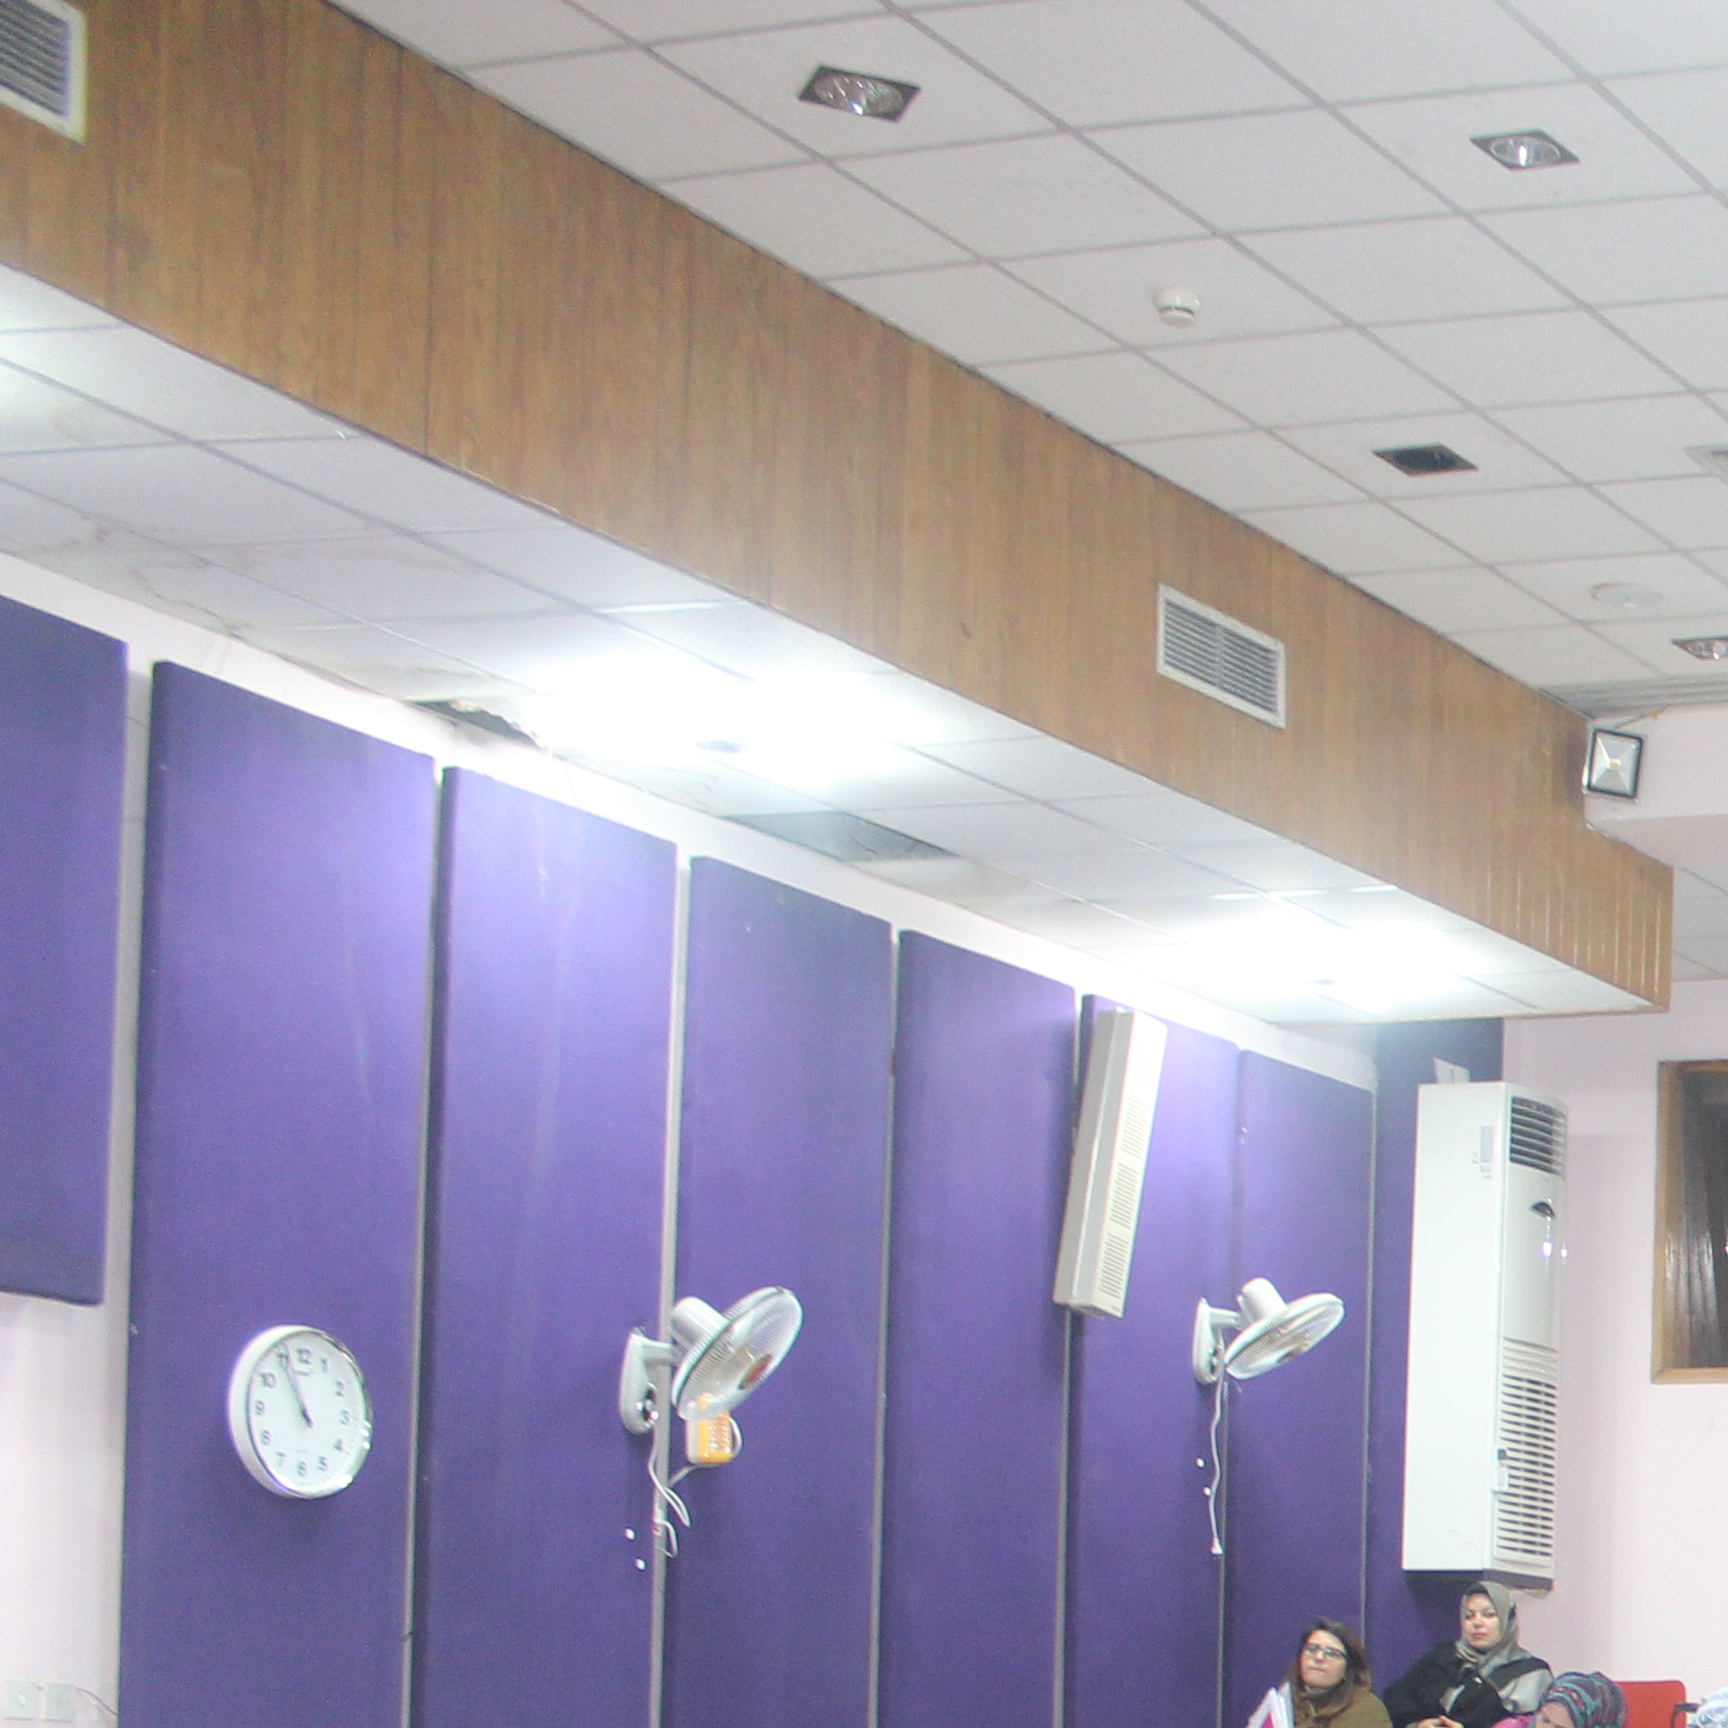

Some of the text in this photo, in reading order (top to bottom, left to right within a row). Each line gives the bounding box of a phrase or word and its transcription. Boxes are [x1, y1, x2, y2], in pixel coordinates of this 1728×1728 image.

[297, 1348, 312, 1365] 12
[320, 1357, 328, 1372] 1
[259, 1372, 277, 1388] 10
[335, 1380, 345, 1397] 2
[255, 1400, 265, 1416] 9
[339, 1409, 350, 1425] 3
[260, 1429, 271, 1446] 8
[334, 1437, 344, 1451] 4
[276, 1451, 287, 1467] 7
[318, 1455, 329, 1472] 5
[298, 1460, 308, 1477] 6
